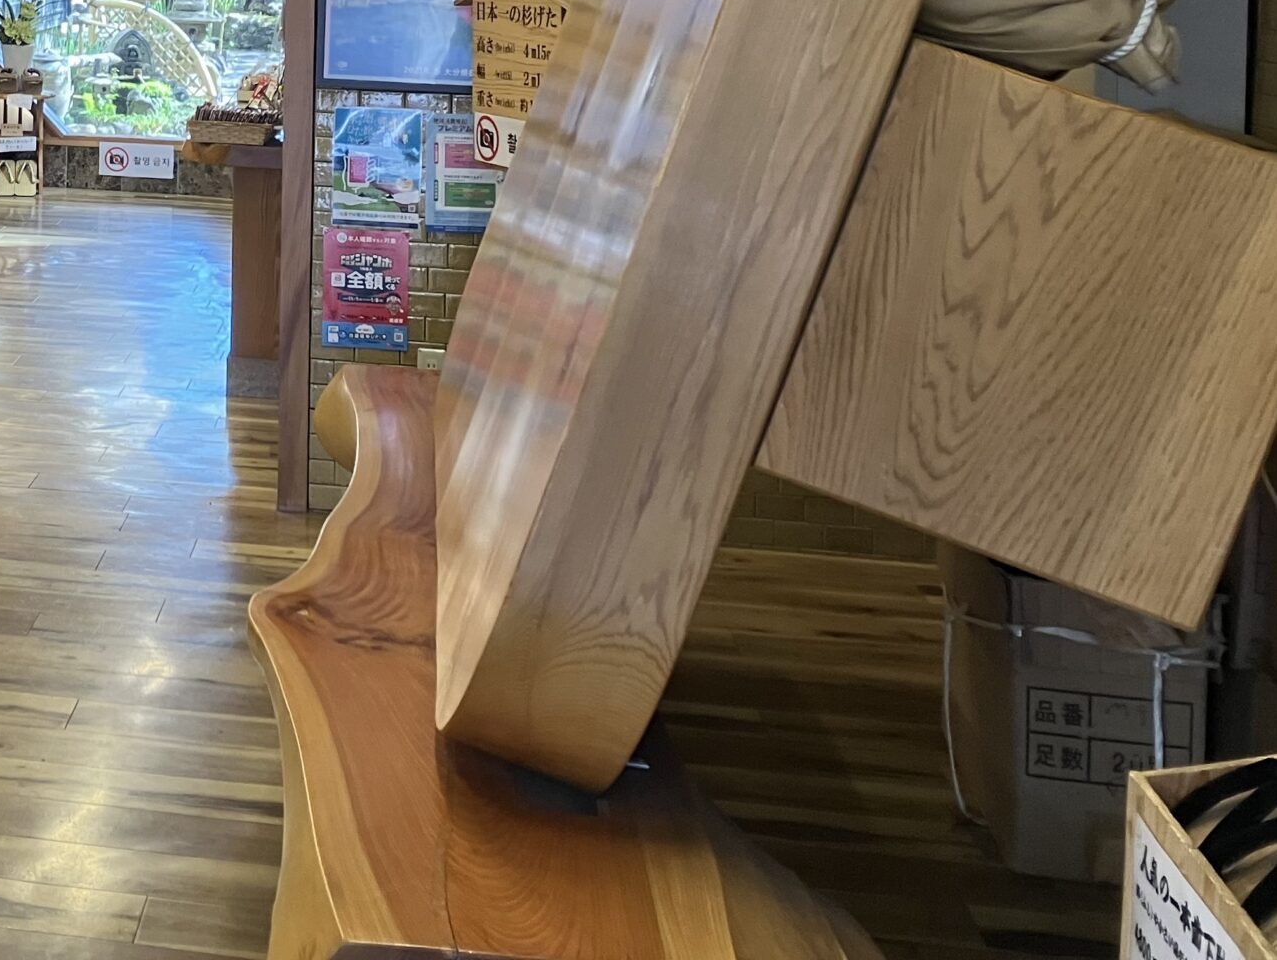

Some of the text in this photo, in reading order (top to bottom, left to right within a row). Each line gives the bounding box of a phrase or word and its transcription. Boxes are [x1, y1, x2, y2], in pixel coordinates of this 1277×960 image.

[477, 35, 493, 54] 高さ
[476, 90, 493, 108] 重さ
[520, 98, 533, 113] 約
[507, 133, 518, 154] 촬
[347, 271, 383, 290] 全額
[1035, 700, 1084, 727] 品番
[1034, 743, 1083, 771] 足数
